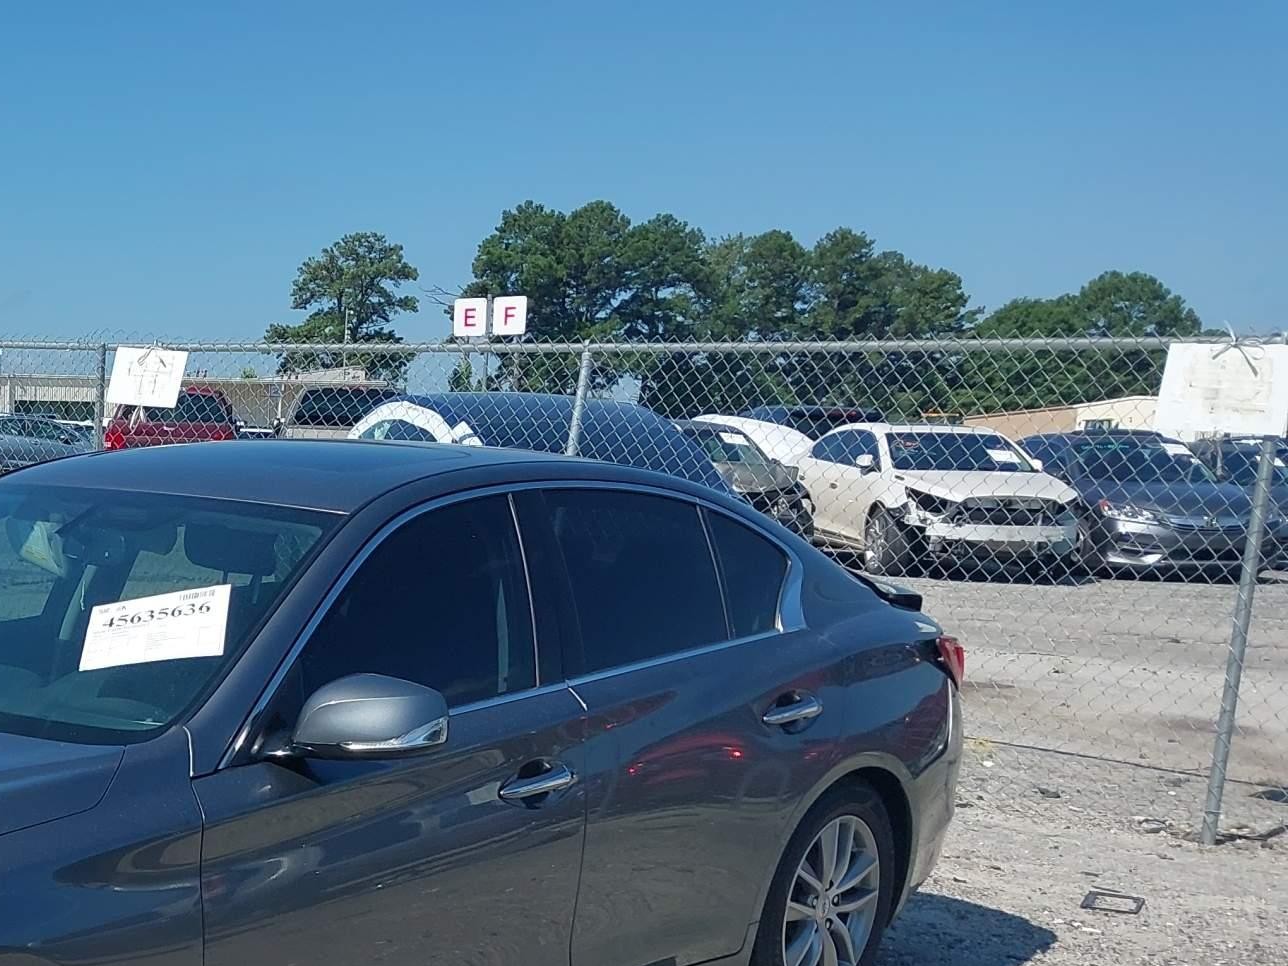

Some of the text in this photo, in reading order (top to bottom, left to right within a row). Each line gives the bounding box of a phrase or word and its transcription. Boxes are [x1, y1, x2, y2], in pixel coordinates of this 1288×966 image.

[464, 308, 477, 327] E
[504, 306, 517, 326] F
[102, 600, 212, 628] 45635636
